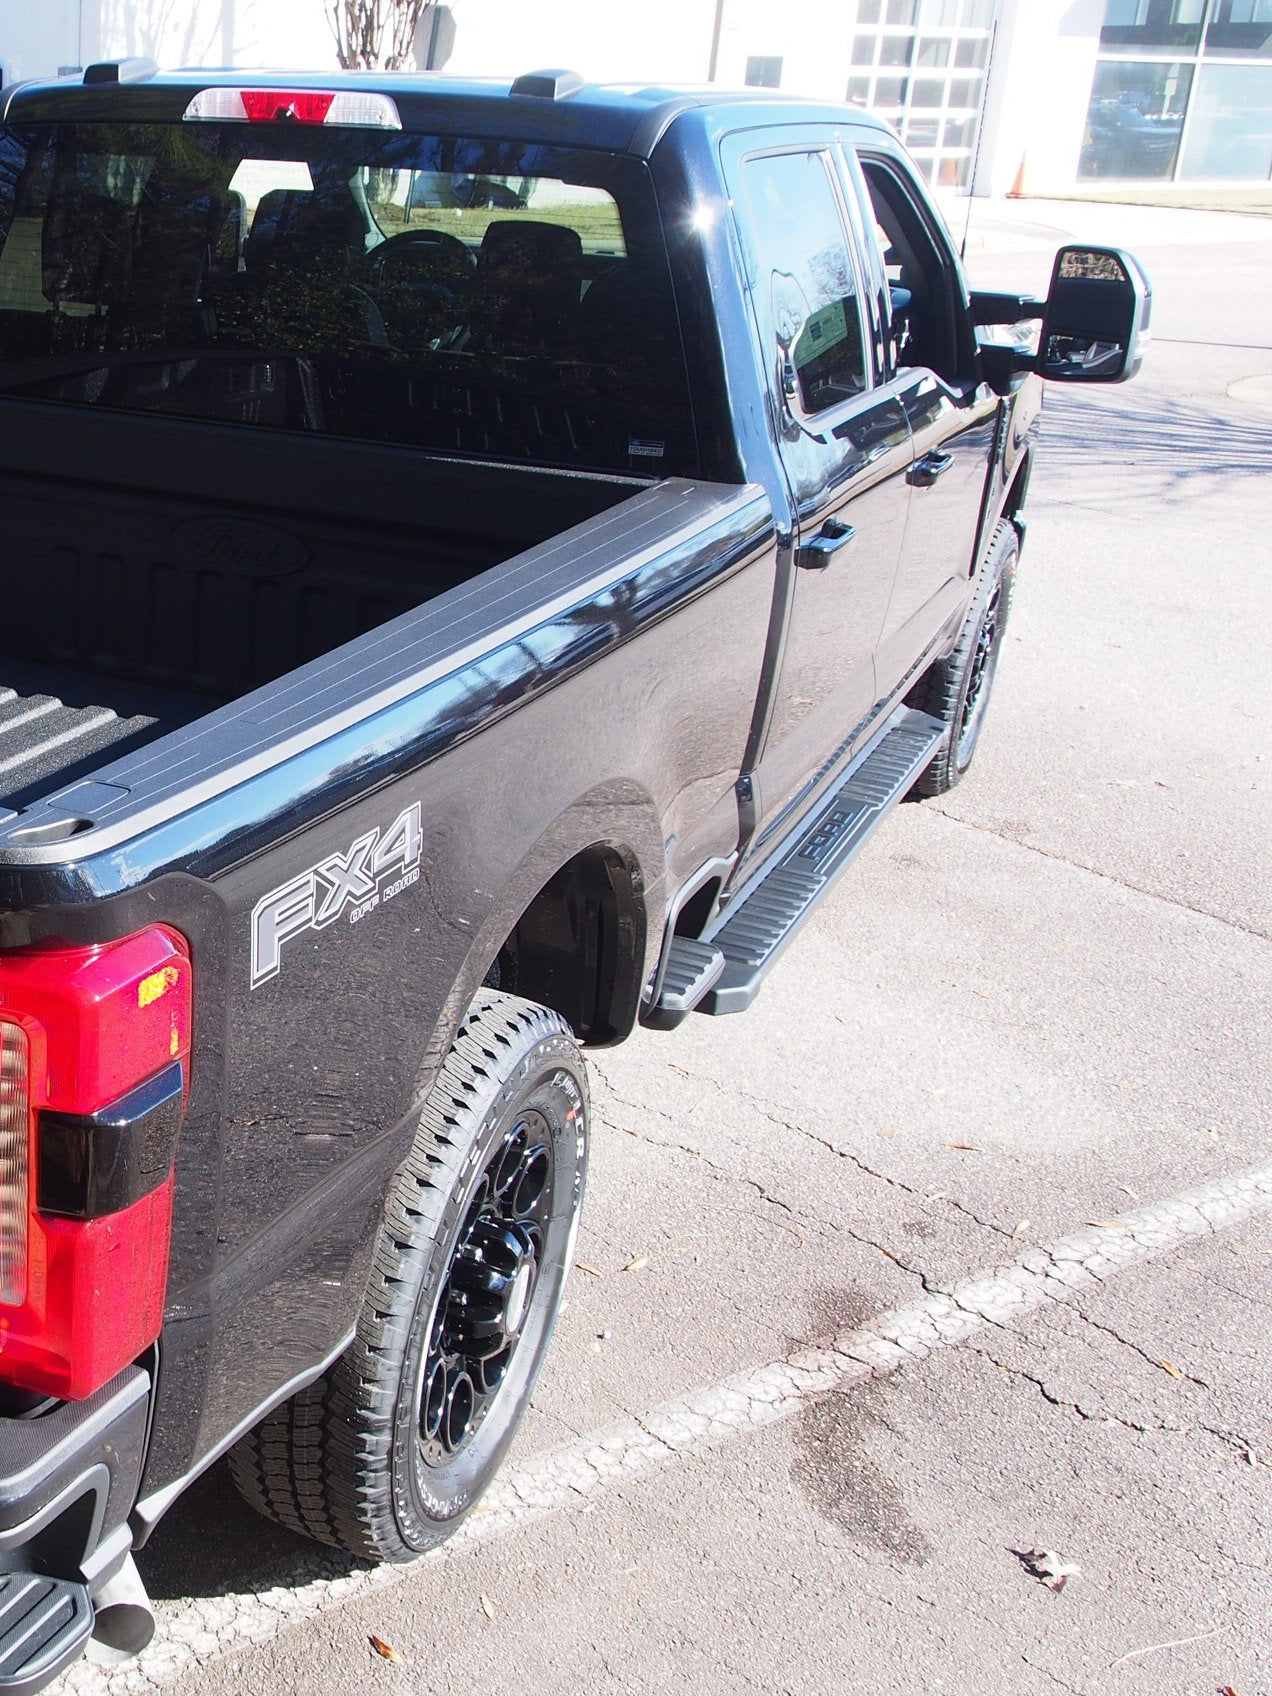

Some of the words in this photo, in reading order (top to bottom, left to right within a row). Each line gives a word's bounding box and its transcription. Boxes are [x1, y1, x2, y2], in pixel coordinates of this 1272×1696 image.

[250, 800, 424, 991] FX4
[349, 893, 380, 924] OFF
[382, 867, 420, 903] ROAD
